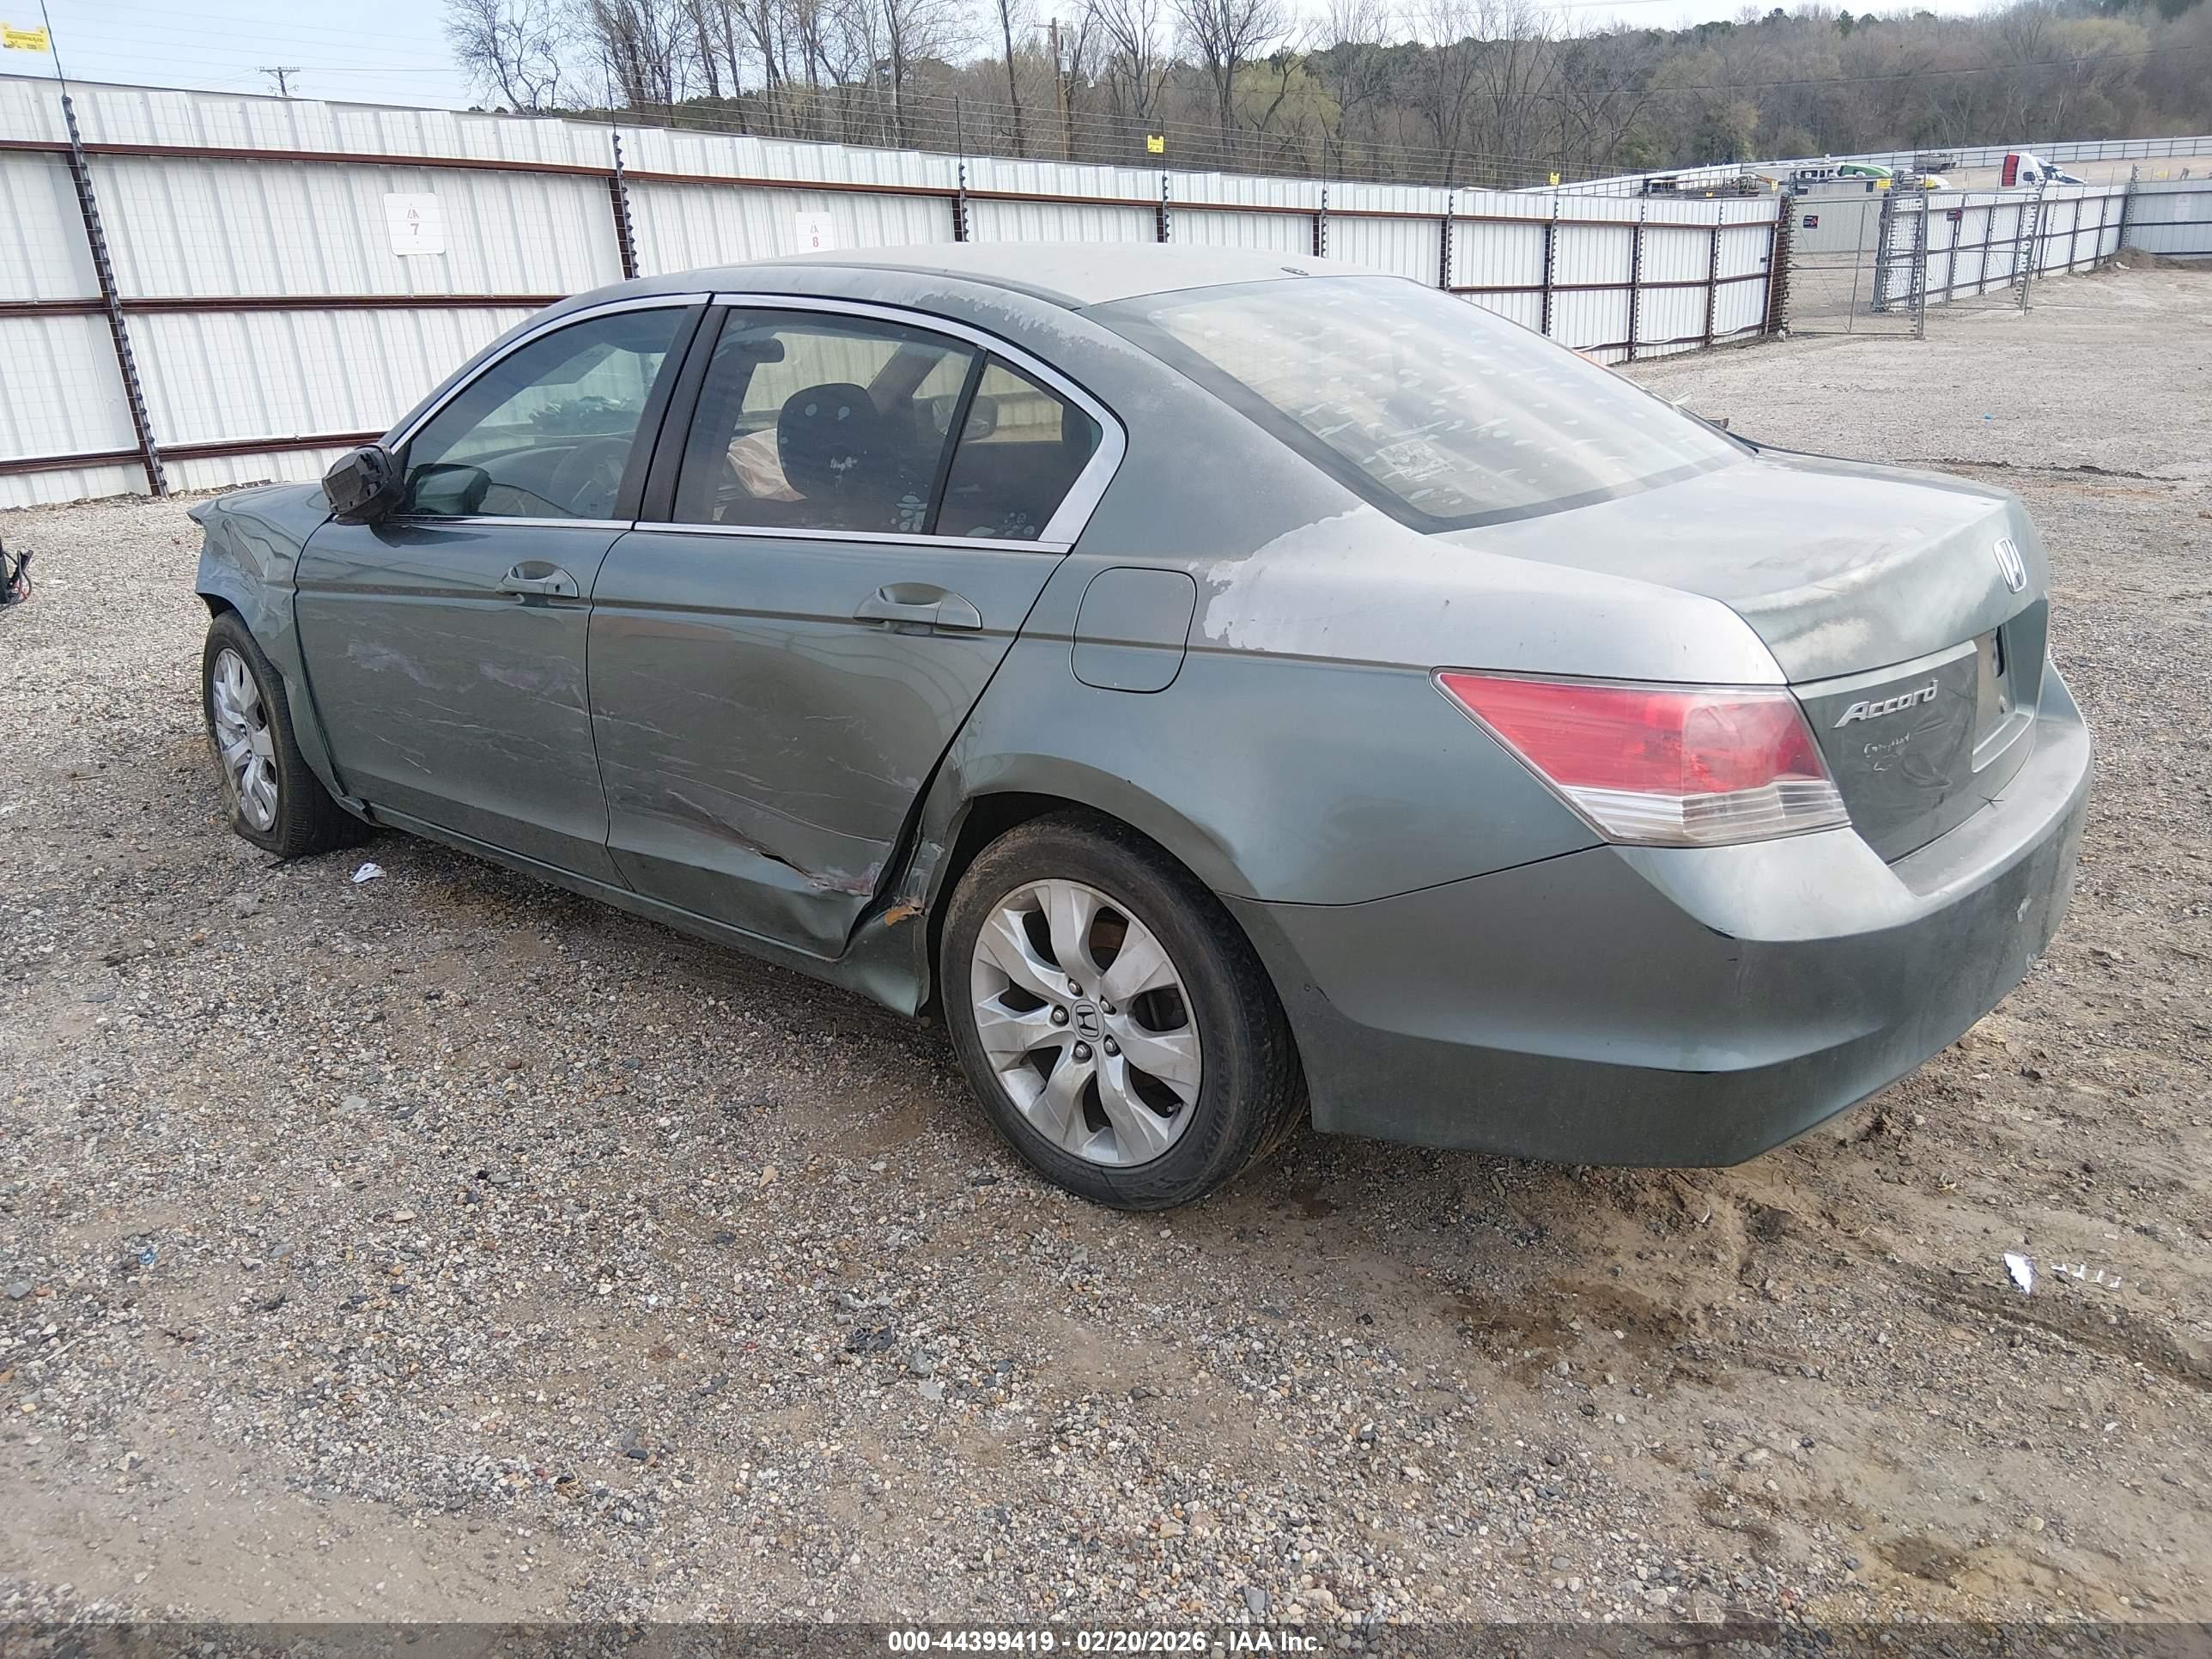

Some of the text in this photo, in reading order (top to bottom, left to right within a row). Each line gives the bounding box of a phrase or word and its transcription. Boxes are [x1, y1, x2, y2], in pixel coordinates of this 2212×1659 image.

[410, 222, 420, 235] 7
[812, 236, 819, 248] 8
[1832, 678, 1939, 728] Accord
